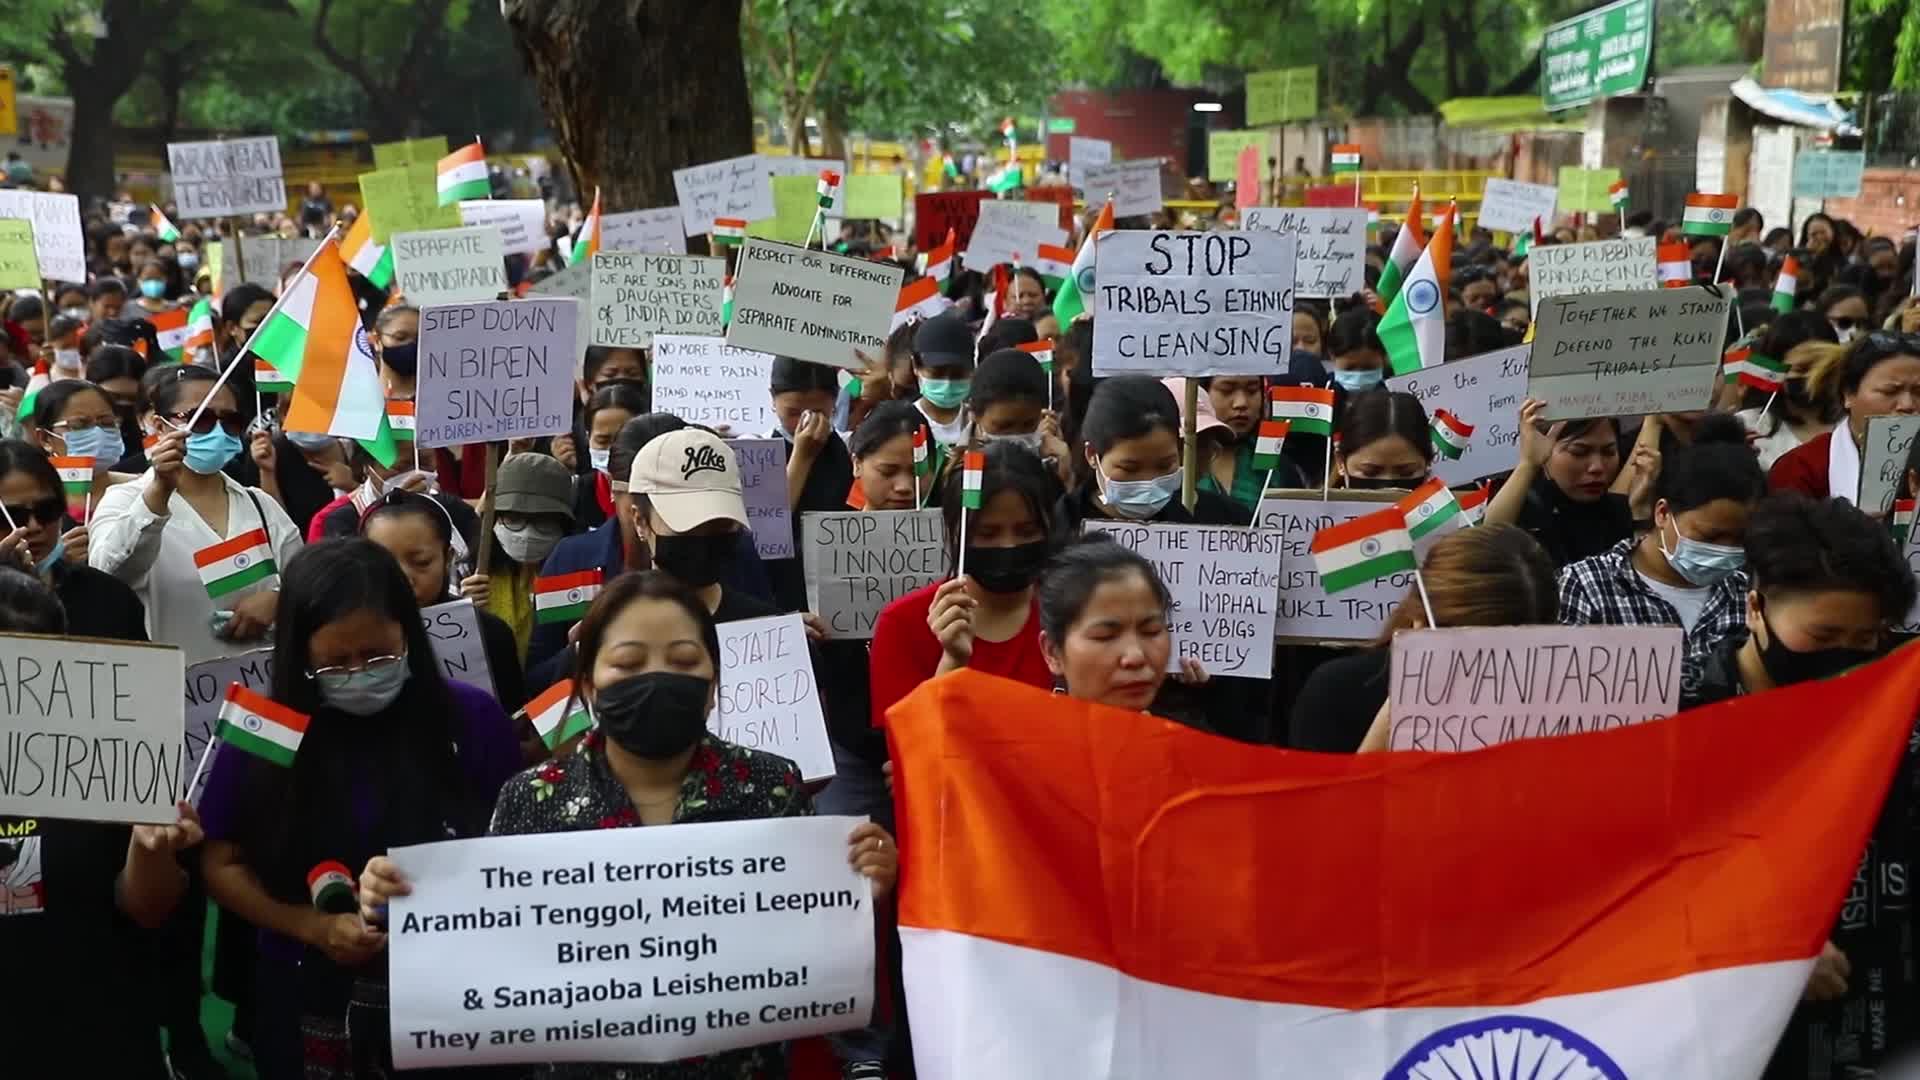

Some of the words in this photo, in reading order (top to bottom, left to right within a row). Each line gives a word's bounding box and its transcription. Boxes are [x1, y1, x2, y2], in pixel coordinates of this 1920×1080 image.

[173, 140, 275, 177] ARAMBAI
[399, 236, 485, 260] SEPARATE
[748, 246, 795, 265] RESPECT
[802, 257, 823, 269] OUR
[1145, 233, 1251, 276] STOP
[1536, 248, 1576, 266] STOP
[595, 255, 635, 270] DEAR
[644, 257, 682, 274] MODI
[688, 260, 705, 274] JI
[1537, 263, 1653, 284] RANSACKING
[599, 275, 617, 284] WE
[623, 275, 648, 287] ARE
[656, 277, 686, 289] SONS
[693, 278, 720, 290] AND
[772, 282, 822, 303] ADVOCATE
[833, 295, 853, 308] FOR
[616, 288, 713, 310] DAUGHTERS
[1102, 285, 1211, 315] TRIBALS
[1225, 288, 1292, 313] ETHNIC
[425, 308, 476, 331] STEP
[484, 307, 556, 332] DOWN
[625, 303, 671, 324] INDIA
[675, 310, 693, 325] DO
[696, 310, 722, 326] OUR
[1556, 301, 1638, 326] TOGETHER
[1649, 305, 1668, 319] WE
[596, 327, 641, 345] LIVES
[737, 308, 797, 333] SEPARATE
[800, 322, 886, 348] ADMINISTRATION
[658, 344, 676, 356] NO
[679, 344, 710, 356] MORE
[1118, 325, 1283, 364] CLEANSING
[1553, 338, 1613, 358] DEFEND
[1629, 335, 1658, 351] THE
[1673, 331, 1713, 347] KUKI
[429, 352, 448, 378] N
[460, 345, 548, 379] BIREN
[656, 365, 675, 376] NO
[680, 366, 711, 376] MORE
[655, 387, 688, 399] STAND
[694, 389, 742, 402] AGAINST
[1408, 379, 1441, 401] Save
[1454, 372, 1478, 390] the
[447, 386, 540, 420] SINGH
[1488, 393, 1517, 413] from
[444, 421, 483, 440] BIREN
[496, 415, 540, 433] MEITEI
[543, 414, 561, 428] CM
[1486, 424, 1520, 447] Sing
[680, 445, 727, 479] Nike
[816, 516, 877, 545] STOP
[1264, 513, 1335, 534] STAND
[1154, 530, 1189, 550] THE
[1198, 529, 1283, 555] TERRORIST
[1198, 560, 1279, 589] Narrative
[1199, 591, 1268, 615] IMPHAL
[724, 624, 792, 669] STATE
[1398, 644, 1676, 707] HUMANITARIAN
[481, 866, 533, 889] The
[542, 862, 596, 887] real
[604, 855, 734, 884] terrorists
[743, 855, 787, 875] are
[401, 904, 522, 934] Arambai
[531, 899, 651, 930] Tenggol,
[662, 892, 747, 920] Meitei
[756, 887, 861, 914] Leepun,
[557, 938, 630, 965] Biren
[639, 934, 718, 963] Singh
[463, 988, 485, 1011] &
[494, 977, 643, 1011] Sanajaoba
[652, 966, 809, 998] Leishemba!
[410, 1030, 481, 1052] They
[489, 1025, 536, 1045] are
[545, 1013, 697, 1044] misleading
[705, 1008, 751, 1030] the
[758, 996, 857, 1025] Centre!
